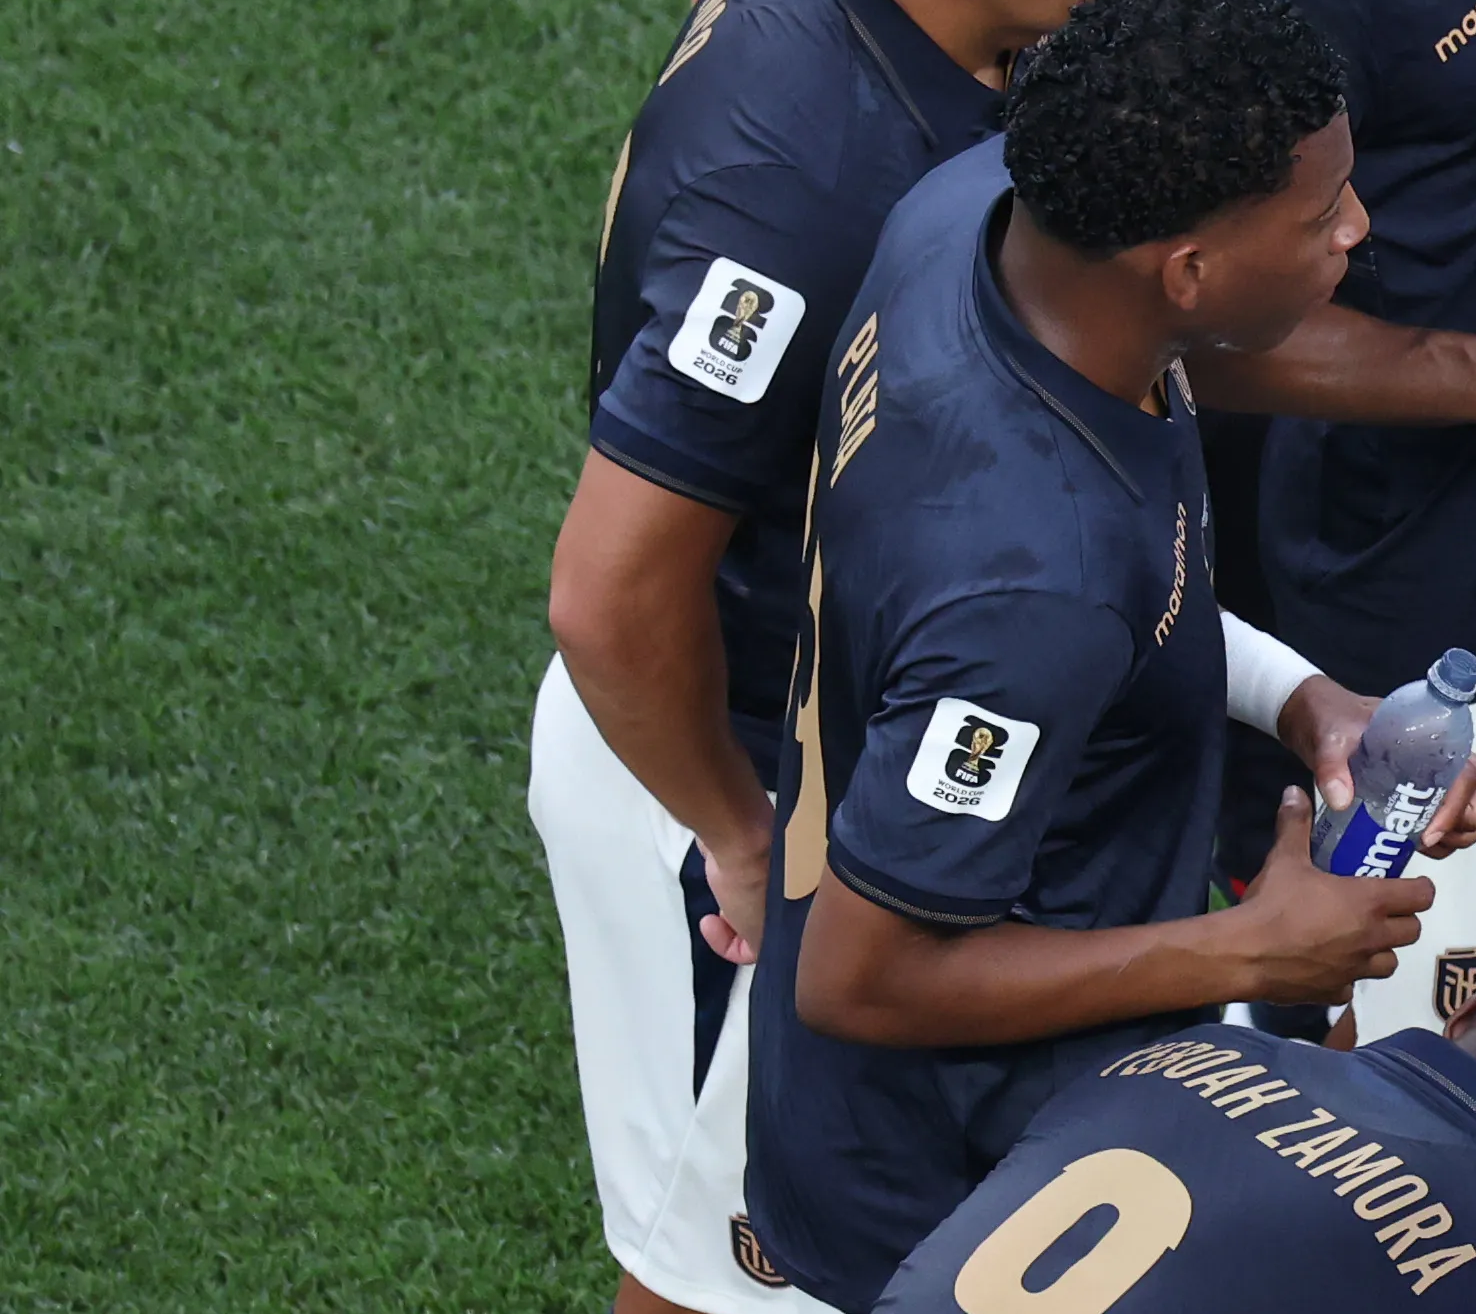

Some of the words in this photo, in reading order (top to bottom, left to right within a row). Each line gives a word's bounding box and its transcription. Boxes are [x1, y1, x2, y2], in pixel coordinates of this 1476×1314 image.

[693, 357, 739, 386] 2026
[1153, 501, 1187, 647] marathon
[938, 779, 968, 796] WORLD
[955, 768, 979, 784] FIFA
[933, 787, 981, 806] 2026
[1354, 782, 1435, 879] smart
[1099, 1041, 1301, 1120] YEBOAH
